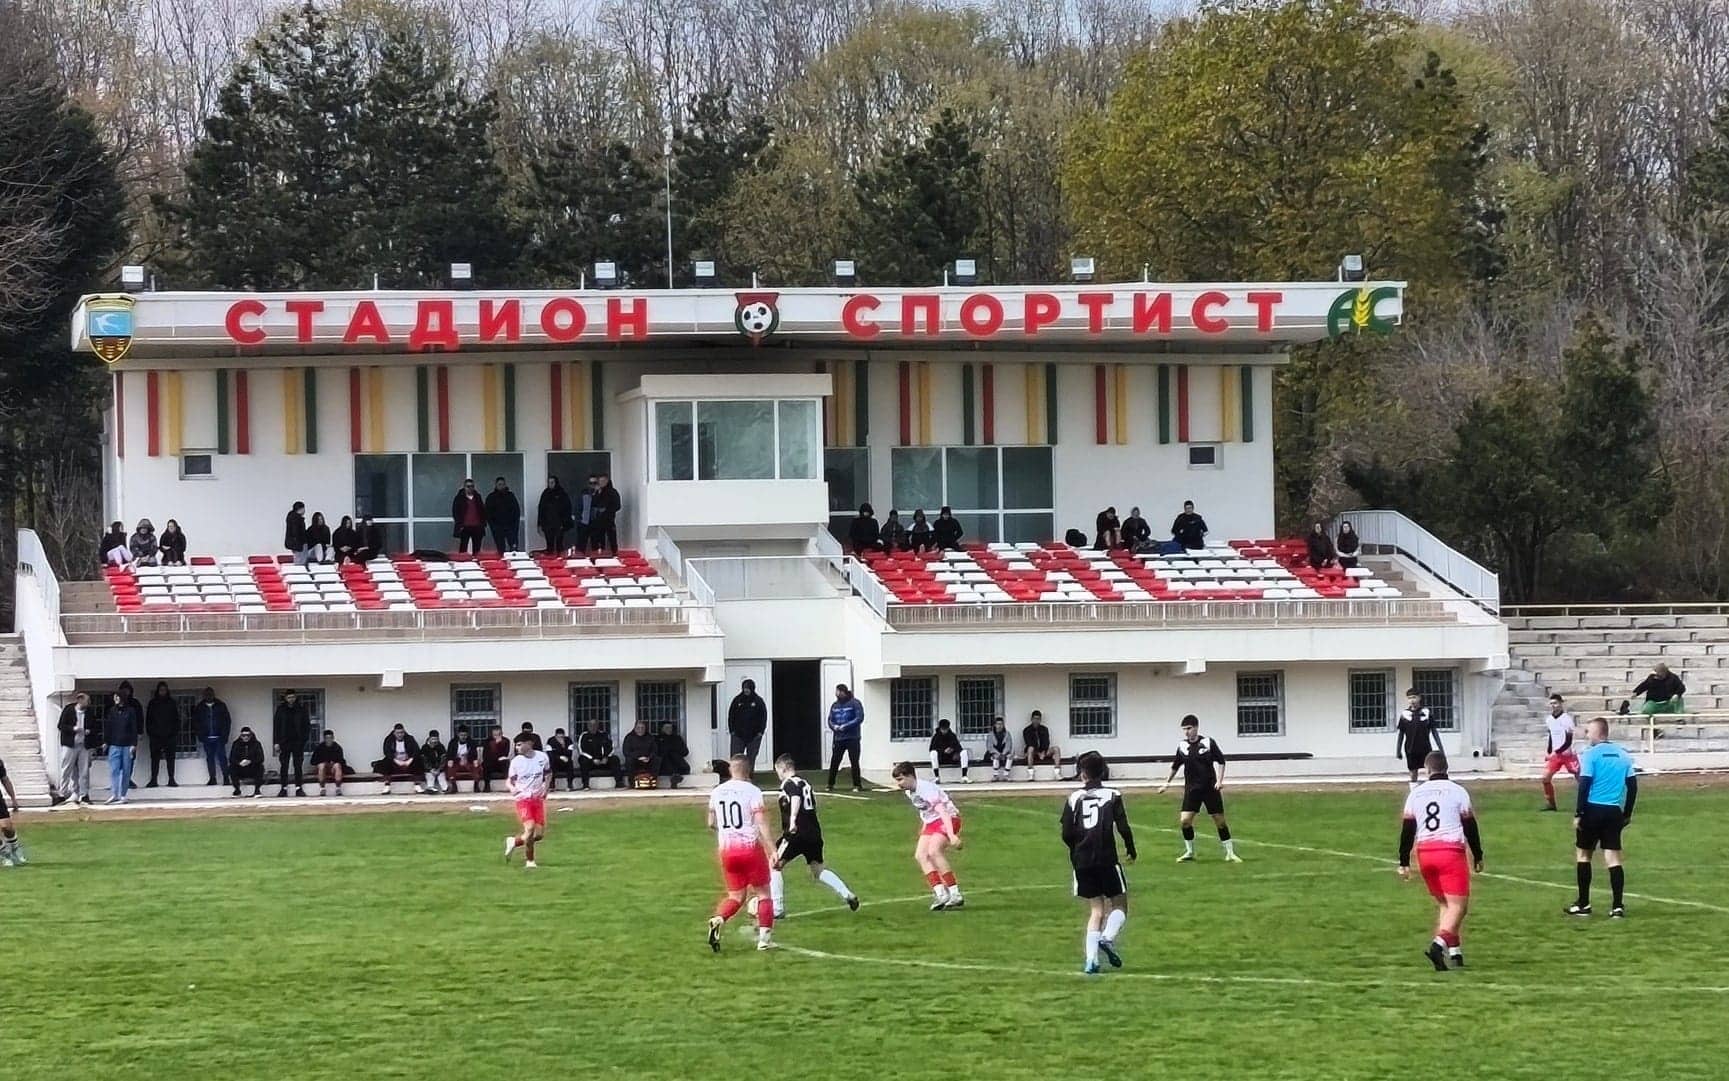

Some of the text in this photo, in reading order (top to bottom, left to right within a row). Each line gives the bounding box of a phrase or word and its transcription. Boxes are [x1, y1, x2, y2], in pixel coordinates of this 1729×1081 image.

[225, 291, 1283, 350] СТАДИОН СПОРТИСТ
[719, 800, 743, 829] 10
[1082, 799, 1099, 829] 5
[1424, 801, 1440, 832] 8
